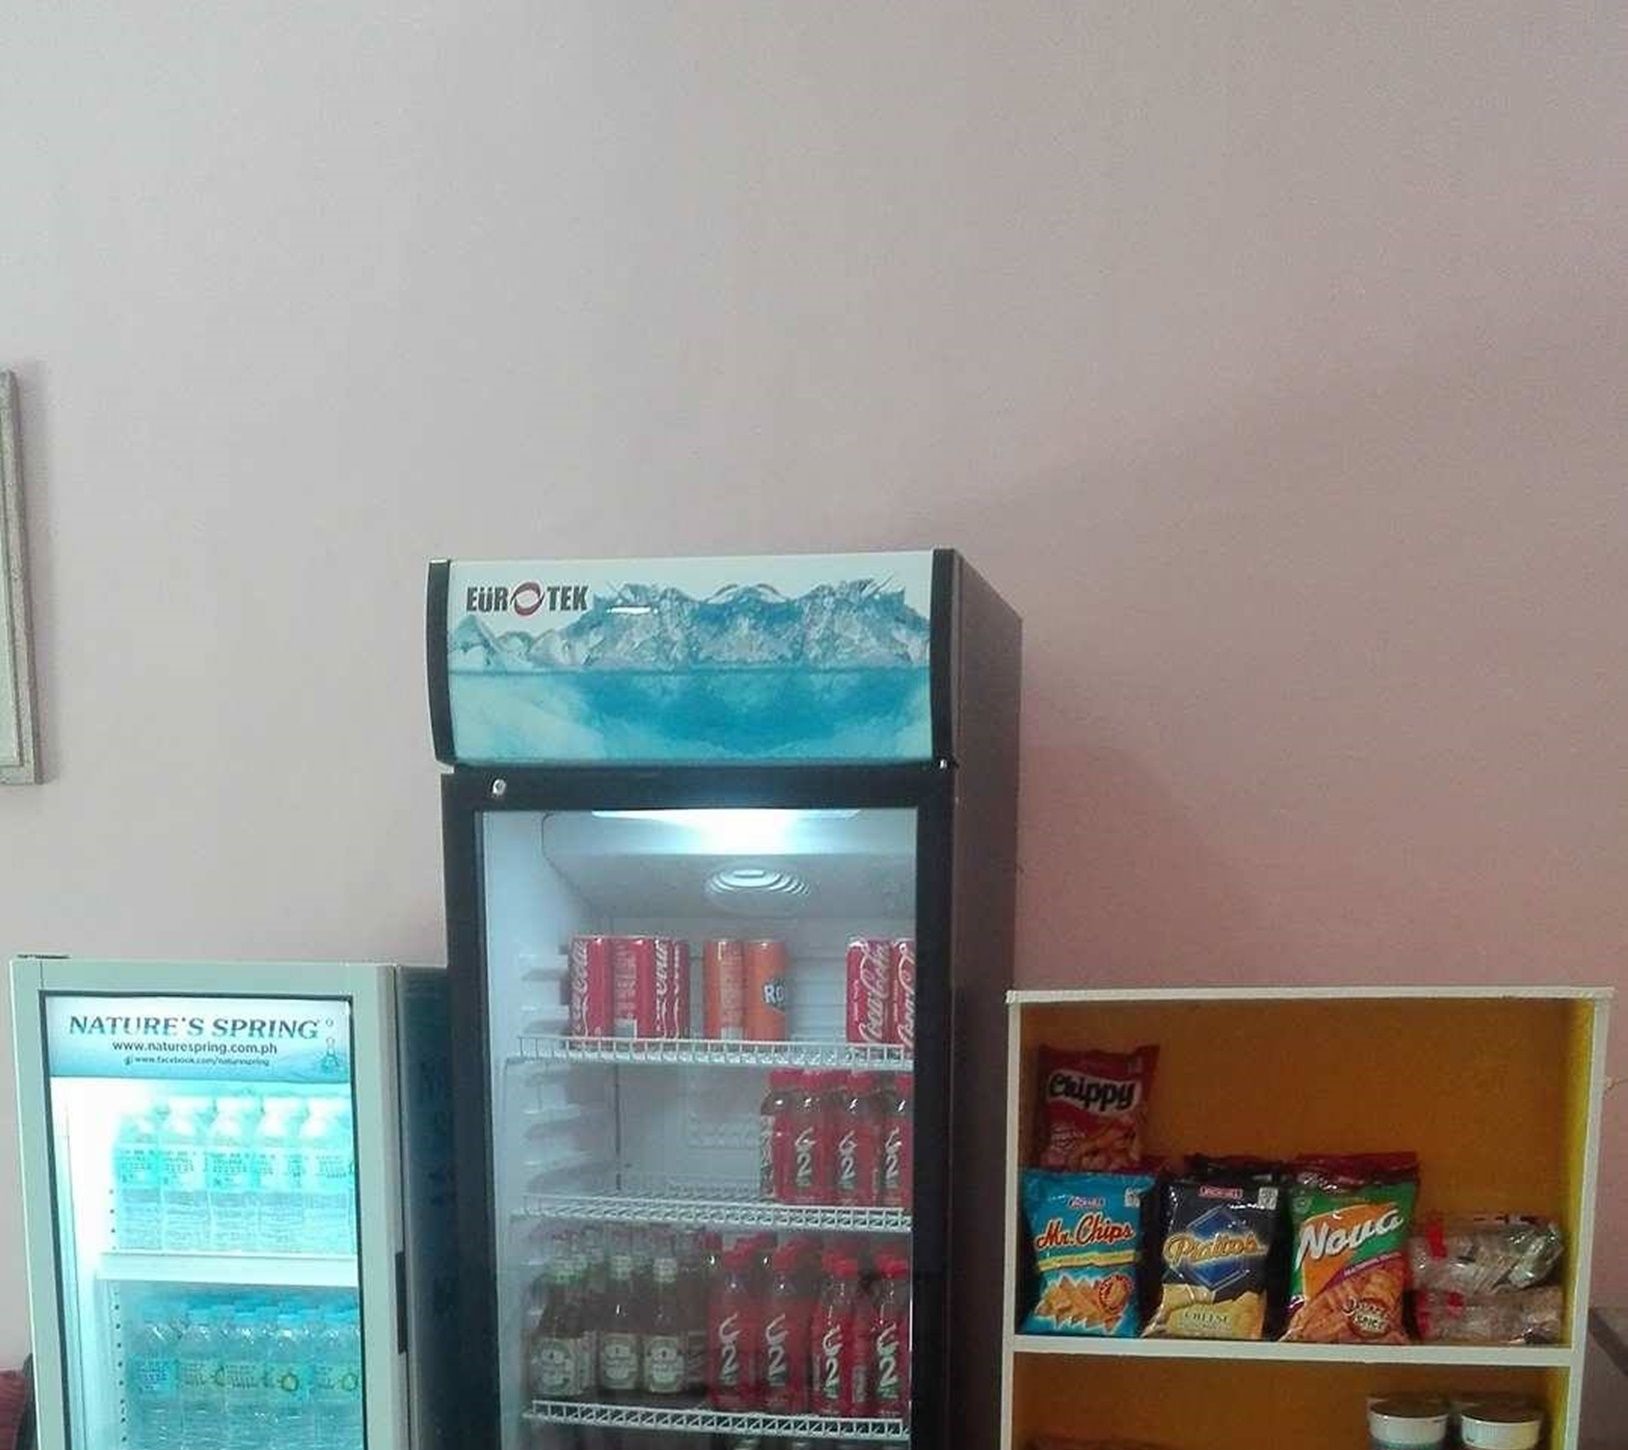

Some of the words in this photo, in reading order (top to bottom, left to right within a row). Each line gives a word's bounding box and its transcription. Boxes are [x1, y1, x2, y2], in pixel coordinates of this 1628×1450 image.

[69, 1016, 204, 1037] NATURE'S
[212, 1019, 319, 1039] SPRING
[112, 1040, 278, 1055] www.naturespring.com.ph
[1049, 1073, 1137, 1112] Chippy
[1036, 1219, 1073, 1249] Mr.
[1075, 1213, 1135, 1246] Chips
[1295, 1208, 1404, 1271] Nova
